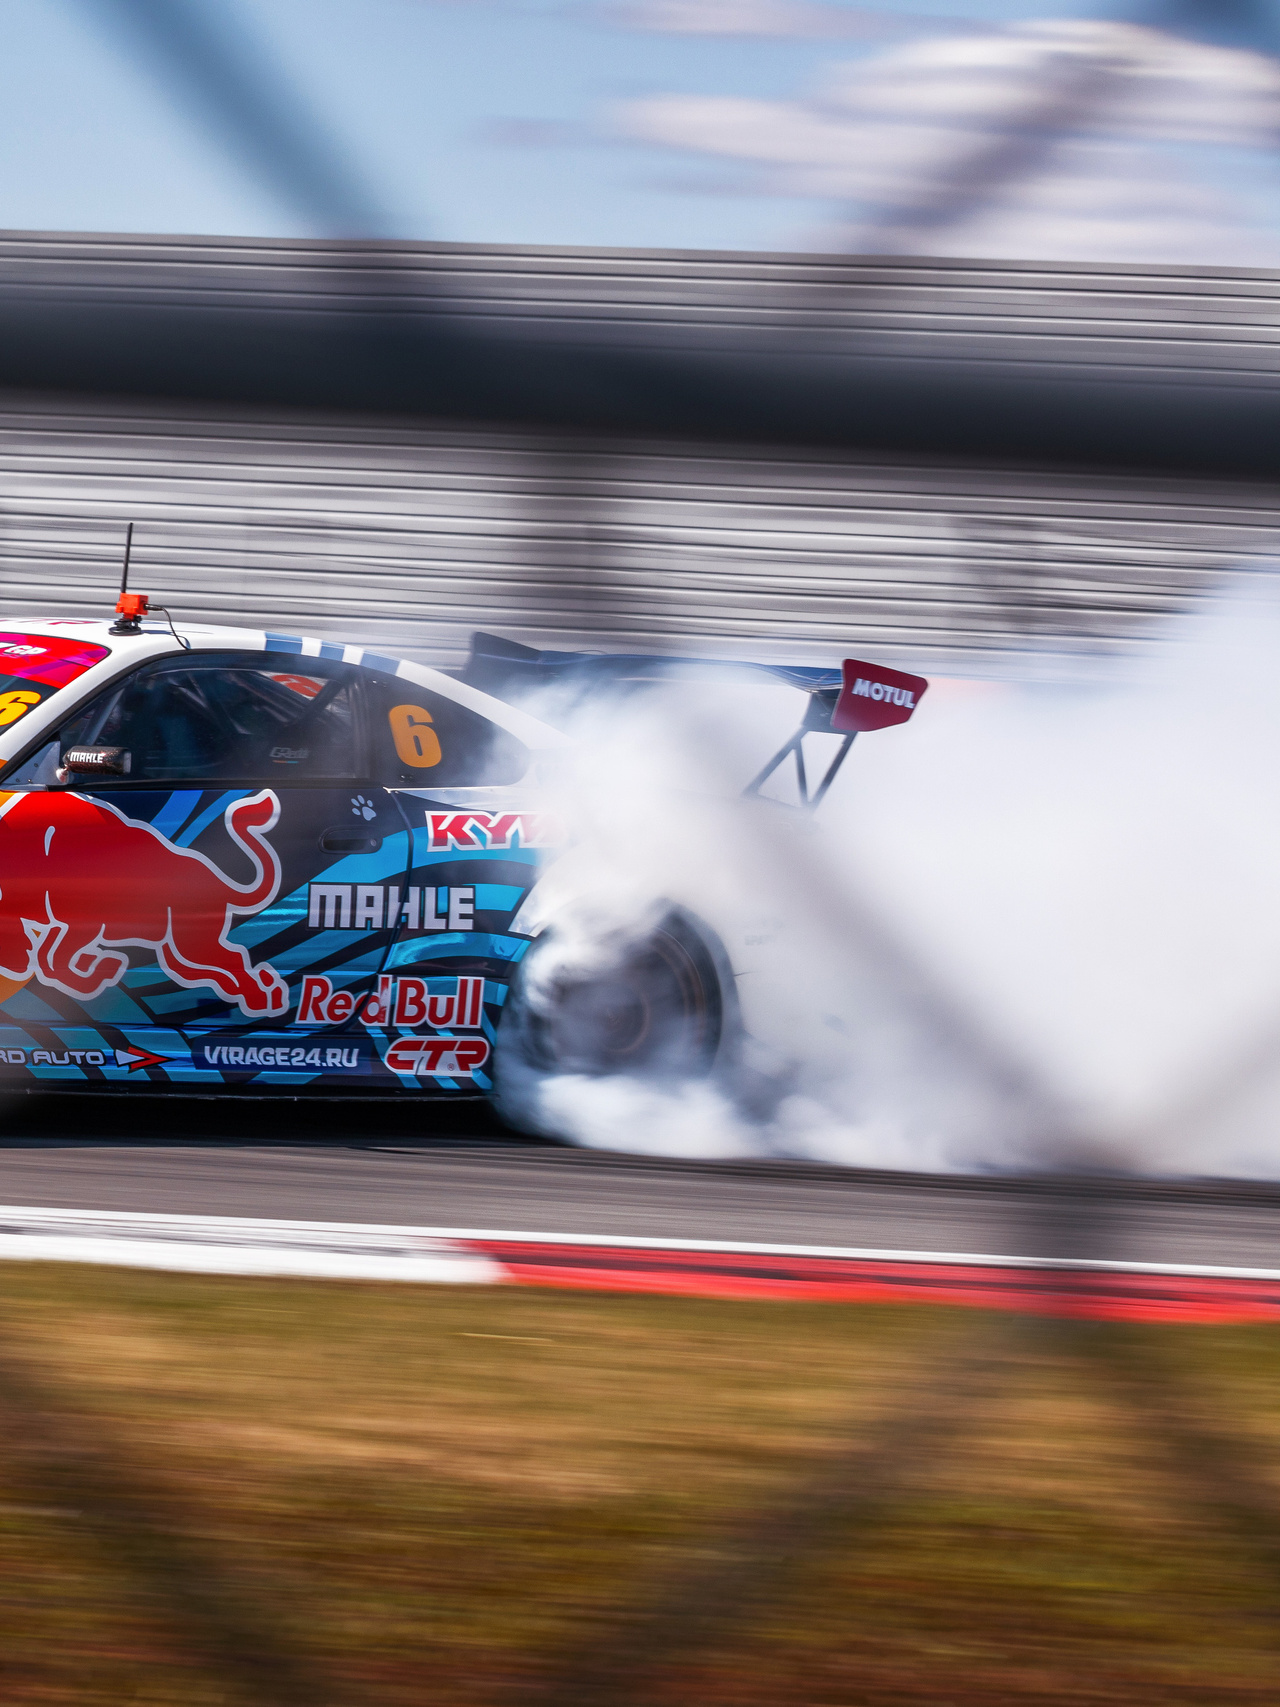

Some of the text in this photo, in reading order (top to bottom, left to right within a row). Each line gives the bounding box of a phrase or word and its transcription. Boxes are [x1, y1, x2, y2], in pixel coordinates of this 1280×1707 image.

[851, 678, 915, 709] MOTUL
[389, 704, 442, 768] 6
[70, 751, 106, 763] MAHLE
[308, 884, 474, 930] MAHLE
[296, 976, 485, 1028] Red Bull
[33, 1048, 105, 1065] AUTO
[204, 1045, 359, 1068] VIRAGE24.RU
[385, 1035, 490, 1077] CTR
